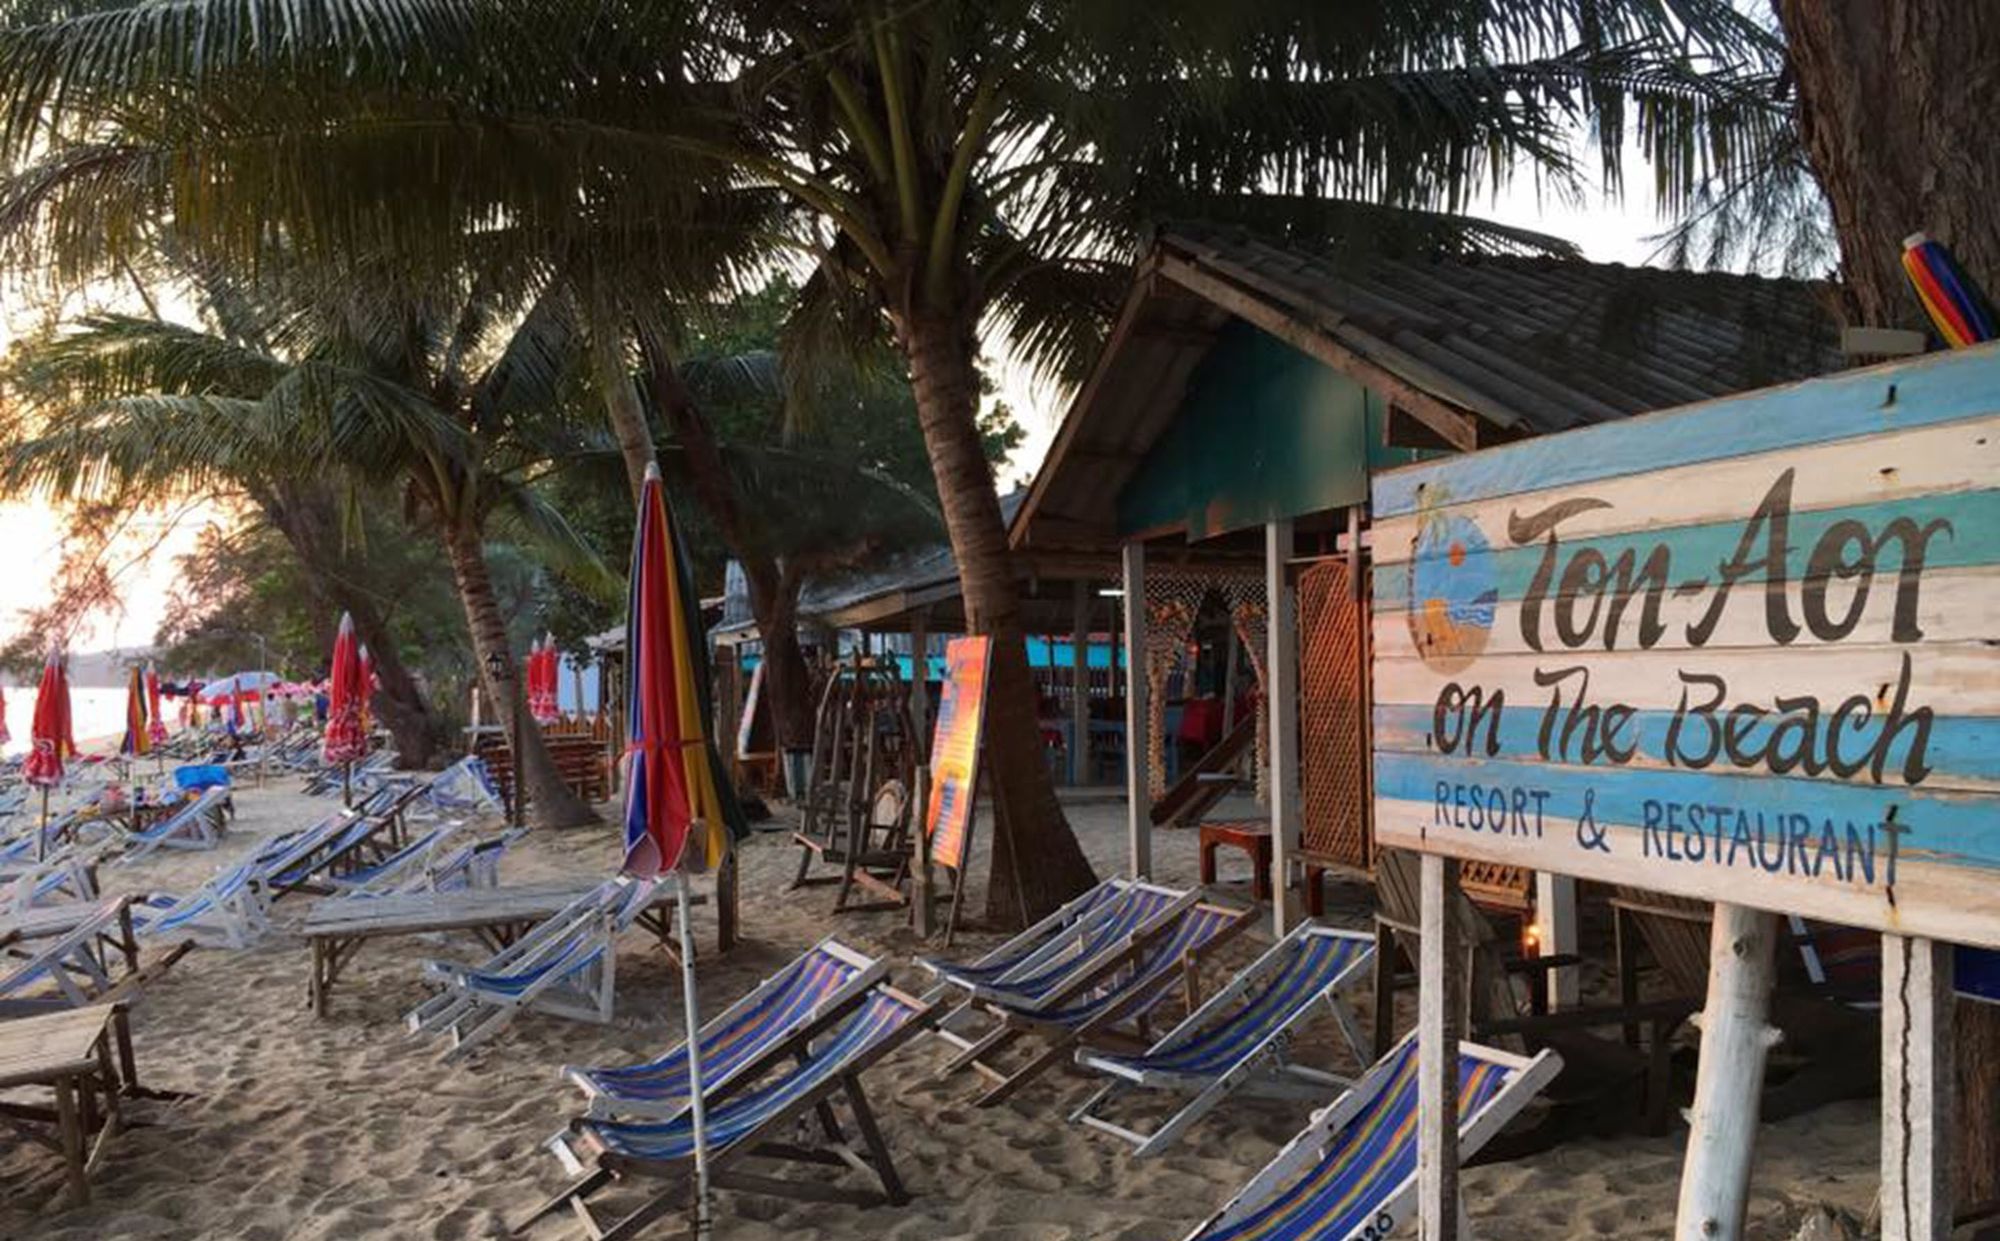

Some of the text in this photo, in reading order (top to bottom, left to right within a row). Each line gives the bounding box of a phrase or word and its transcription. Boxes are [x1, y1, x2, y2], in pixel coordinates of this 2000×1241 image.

[1508, 467, 1954, 652] Ton-Aor
[1431, 650, 1933, 786] on The Beach
[1434, 779, 1912, 886] RESORT & RESTAURANT
